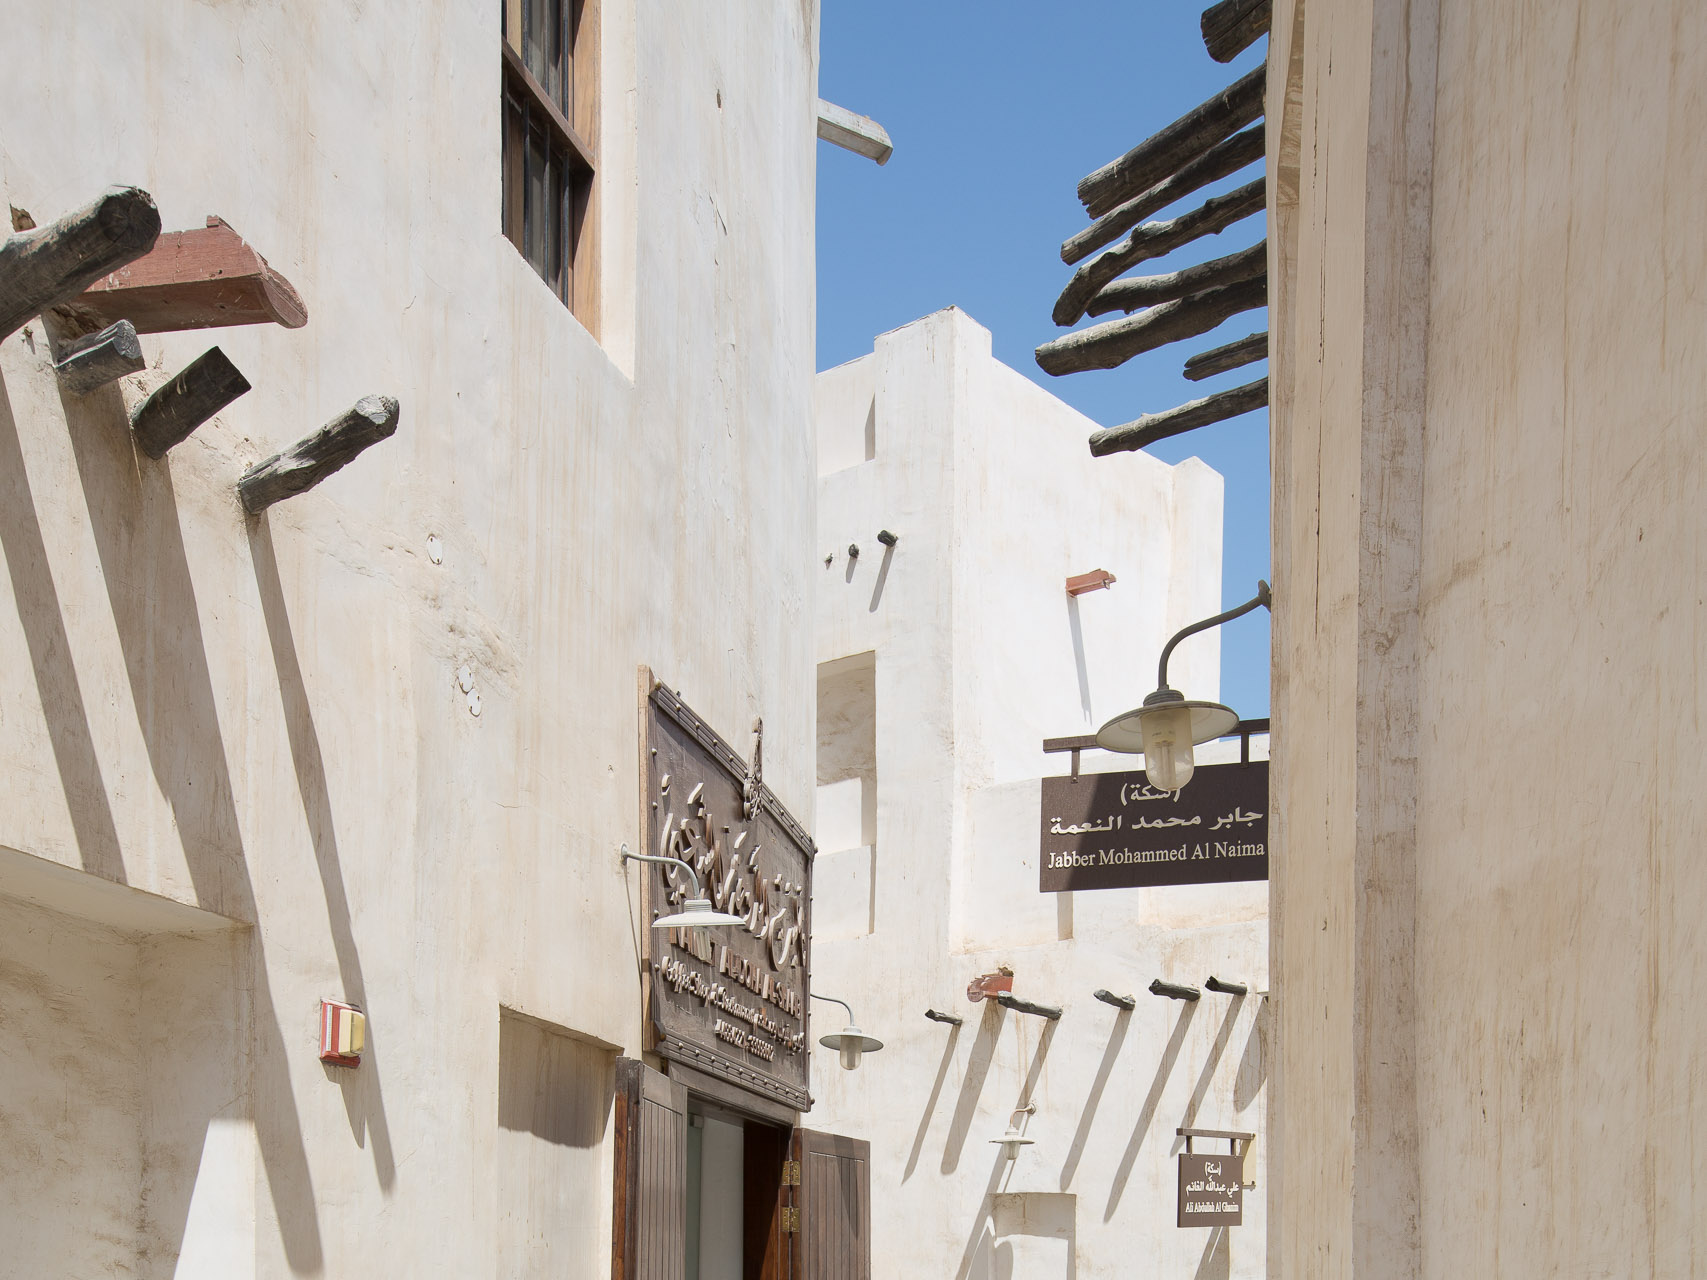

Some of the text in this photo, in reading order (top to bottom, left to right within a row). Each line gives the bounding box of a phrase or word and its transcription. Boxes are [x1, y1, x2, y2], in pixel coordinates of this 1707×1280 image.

[1050, 806, 1264, 835] جابر محمد النعمة
[1048, 840, 1265, 869] Jabber Mohammed Al Naima
[661, 956, 691, 993] Coffee
[1185, 1181, 1205, 1197] الغانم
[1226, 1181, 1240, 1198] علي
[1185, 1202, 1194, 1213] Ali
[1215, 1202, 1222, 1212] Al
